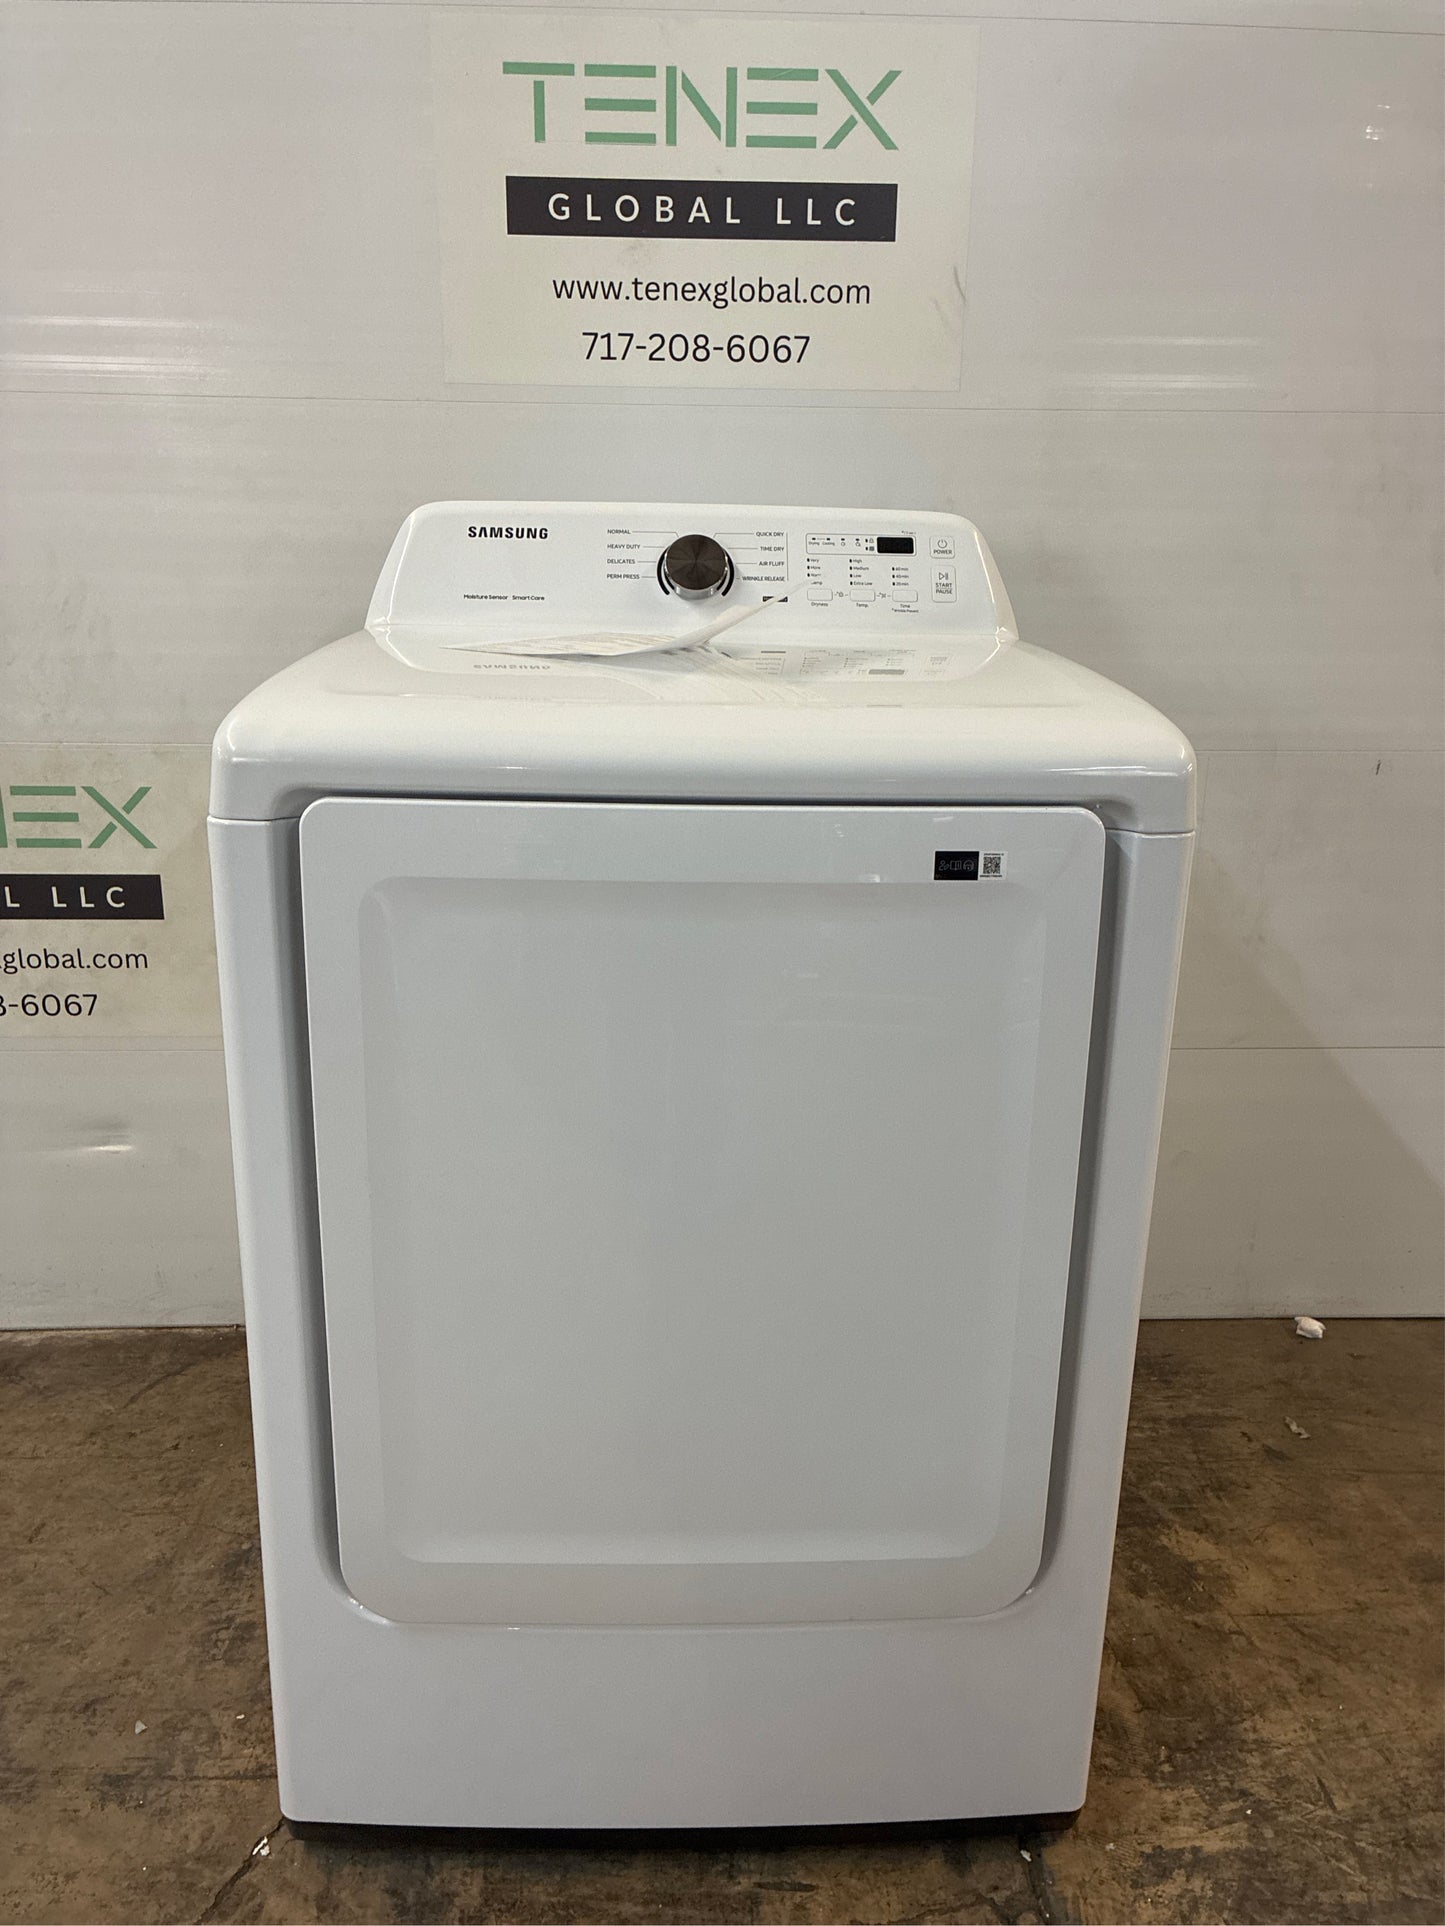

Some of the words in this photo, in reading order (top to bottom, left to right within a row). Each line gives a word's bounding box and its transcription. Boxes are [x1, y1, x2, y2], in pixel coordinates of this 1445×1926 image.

[502, 61, 902, 150] TENEX
[548, 193, 741, 224] GLOBAL
[776, 198, 856, 226] LLC
[552, 277, 870, 308] www.tenexglobal.com
[582, 332, 810, 363] 717-208-6067
[468, 526, 548, 539] SAMSUNG
[0, 786, 157, 848] EX
[51, 886, 125, 908] LLC
[0, 948, 148, 974] global.com
